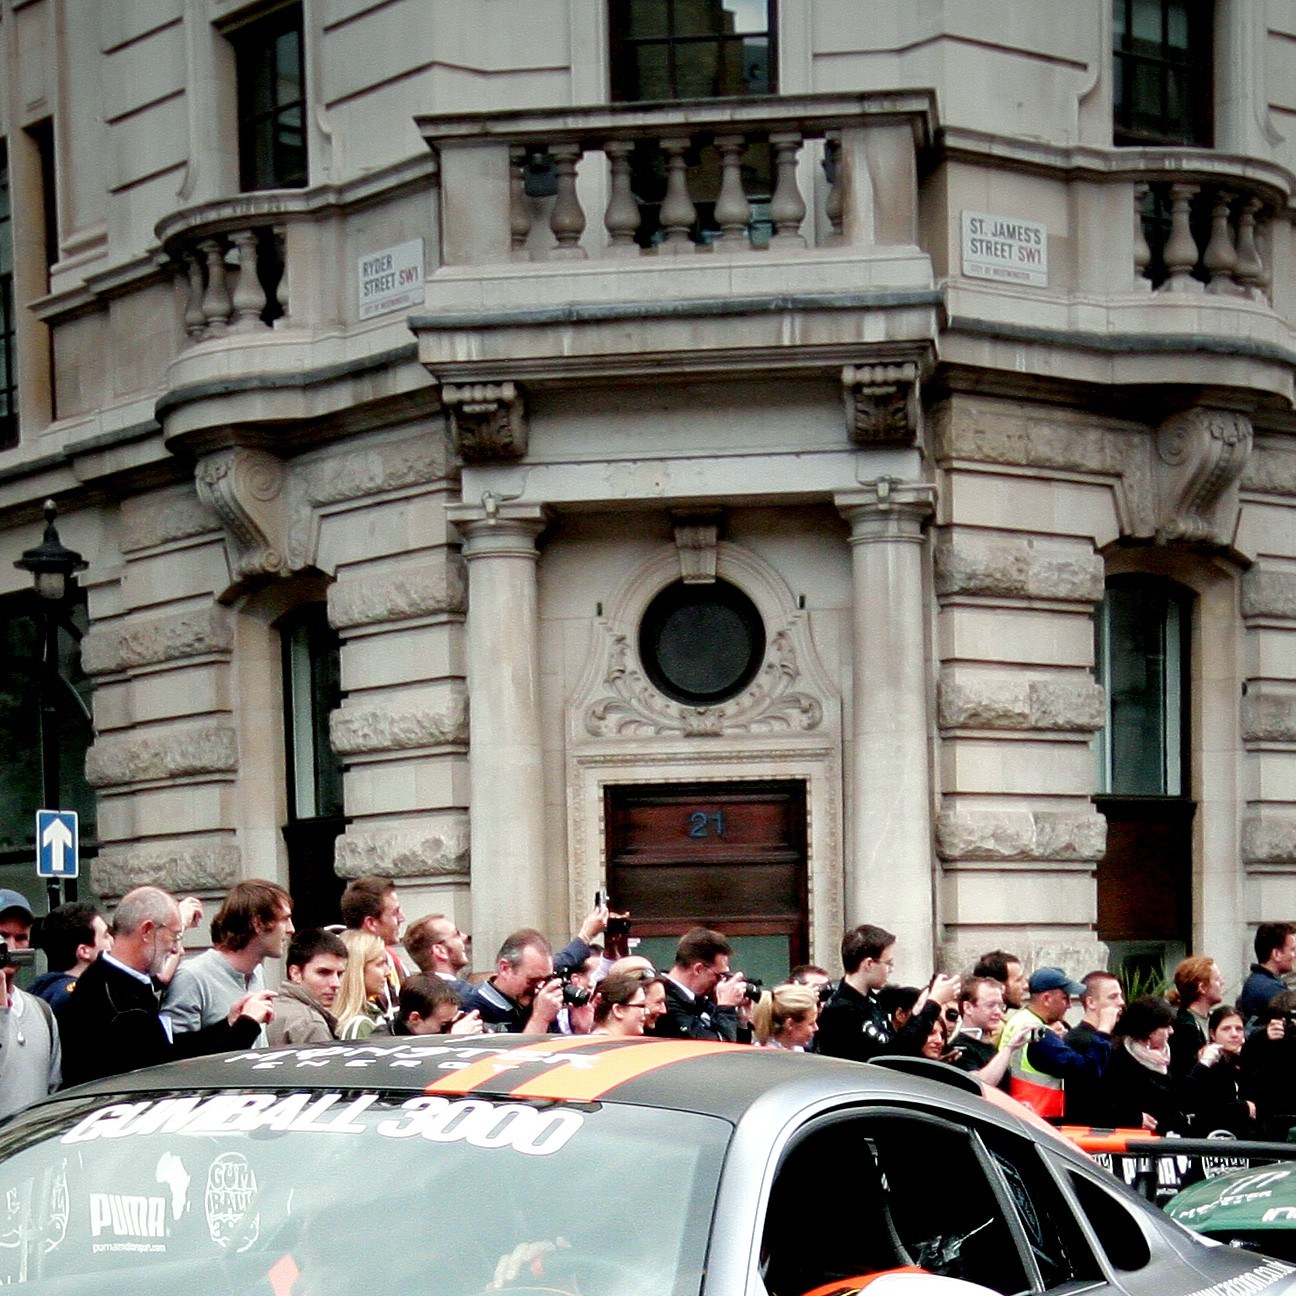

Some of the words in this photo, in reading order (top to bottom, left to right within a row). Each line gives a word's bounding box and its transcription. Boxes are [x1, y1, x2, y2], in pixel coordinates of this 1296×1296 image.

[992, 222, 1042, 246] JAMES'S
[970, 239, 1013, 260] STREET
[1018, 246, 1042, 265] SW1
[364, 272, 396, 298] STREET
[399, 266, 419, 286] SW1
[689, 810, 725, 839] 21
[61, 1092, 368, 1144] GUMBALL
[377, 1096, 585, 1156] 3000
[90, 1193, 166, 1237] PUMA
